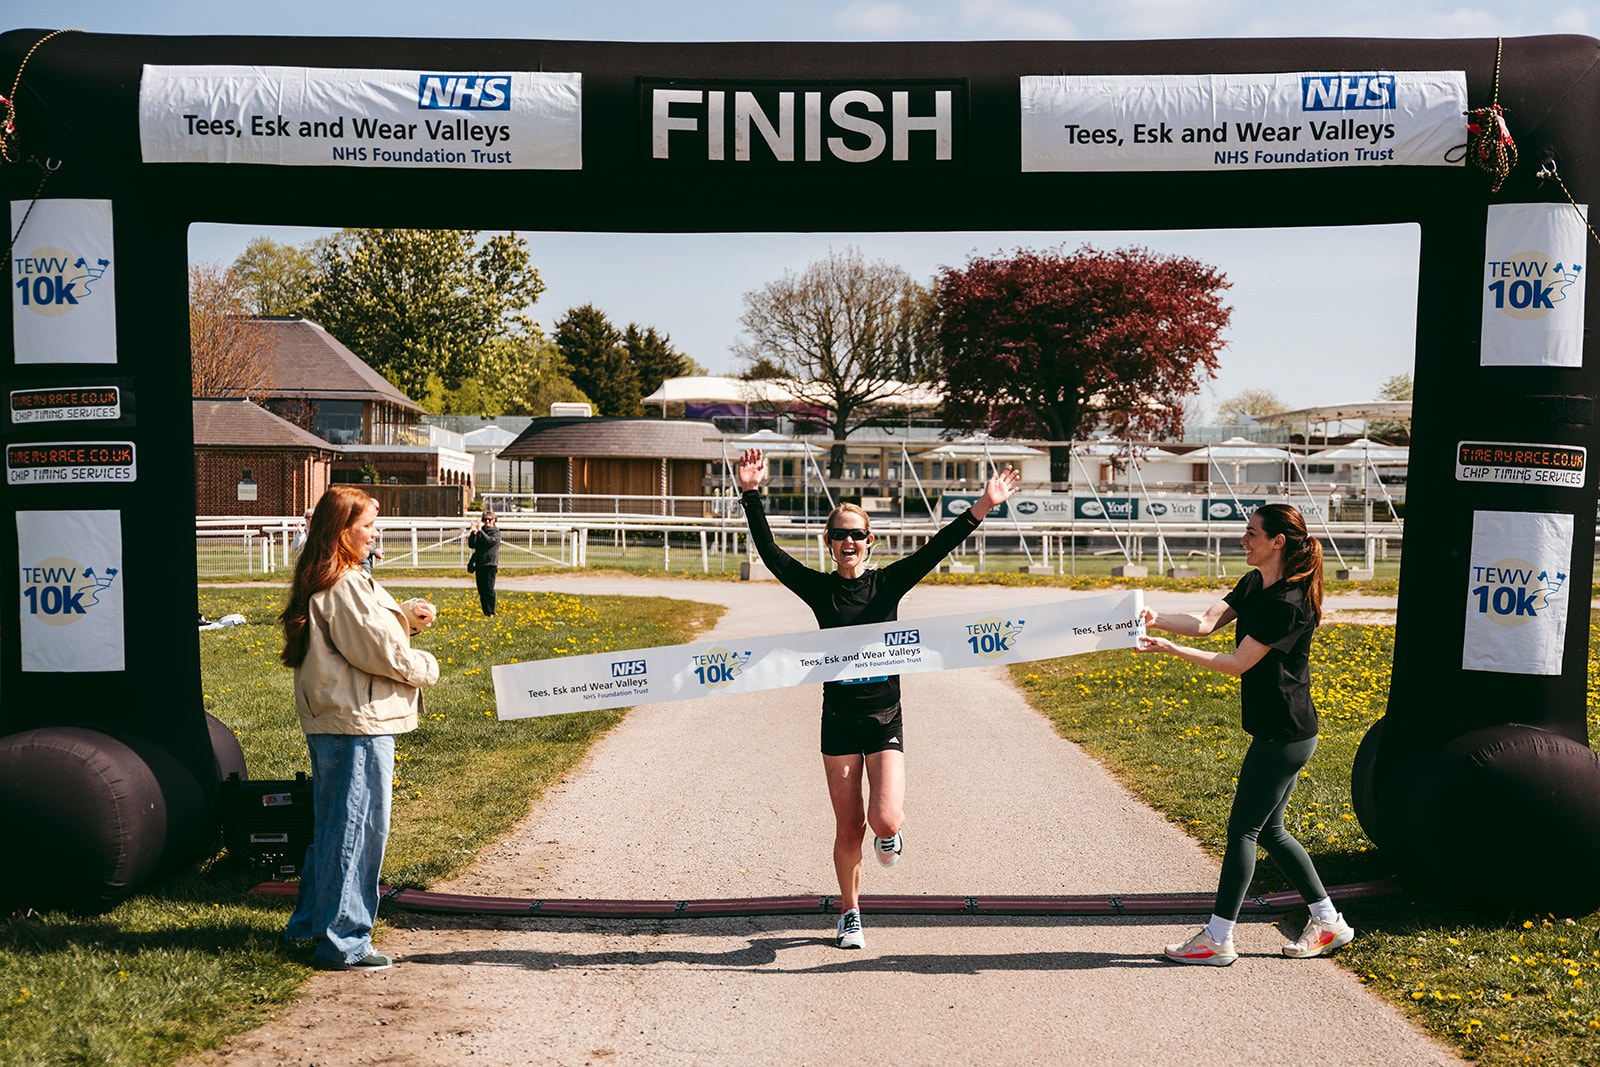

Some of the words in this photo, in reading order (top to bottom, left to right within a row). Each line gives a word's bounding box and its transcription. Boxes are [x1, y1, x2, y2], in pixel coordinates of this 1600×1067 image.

[419, 77, 509, 108] NHS
[1305, 77, 1391, 108] NHS
[183, 114, 242, 138] Tees,
[251, 115, 291, 137] Esk
[298, 116, 344, 138] and
[352, 118, 417, 140] Wear
[424, 119, 511, 147] Valleys
[652, 88, 952, 163] FINISH
[1064, 124, 1124, 146] Tees,
[1133, 122, 1174, 144] Esk
[1181, 122, 1227, 143] and
[1236, 122, 1302, 142] Wear
[1309, 119, 1395, 145] Valleys
[333, 147, 367, 161] NHS
[373, 147, 466, 163] Foundation
[471, 149, 512, 164] Trust
[1214, 150, 1249, 164] NHS
[1254, 149, 1349, 164] Foundation
[1354, 147, 1394, 161] Trust
[14, 257, 68, 274] TEWV
[1488, 261, 1548, 277] TEWV
[16, 275, 79, 305] 10k
[1488, 279, 1554, 309] 10k
[15, 411, 32, 421] CHIP
[35, 409, 64, 420] TIMING
[67, 407, 116, 418] SERVICES
[10, 470, 30, 481] CHIP
[33, 468, 67, 480] TIMING
[71, 467, 130, 479] SERVICES
[1462, 467, 1489, 479] CHIP
[1494, 468, 1531, 480] TIMING
[1535, 470, 1581, 485] SERVICES
[1042, 501, 1068, 512] York
[1106, 501, 1133, 513] York
[1171, 503, 1196, 513] York
[22, 567, 76, 583] TEWV
[1473, 566, 1533, 585] TEWV
[23, 585, 87, 615] 10k
[1472, 585, 1538, 617] 10k
[965, 621, 1002, 635] TEWV
[1072, 627, 1095, 635] Tees,
[1097, 622, 1113, 632] Esk
[1115, 619, 1133, 630] and
[886, 630, 918, 646] NHS
[967, 632, 1010, 654] 10k
[692, 652, 728, 666] TEWV
[800, 658, 823, 667] Tees,
[824, 654, 840, 664] Esk
[842, 651, 859, 662] and
[861, 650, 886, 660] Wear
[888, 646, 921, 658] Valleys
[869, 659, 905, 668] Foundation
[613, 660, 645, 676] NHS
[694, 663, 735, 684] 10k
[528, 690, 550, 698] Tees,
[553, 686, 568, 695] Esk
[570, 683, 587, 694] and
[589, 681, 613, 691] Wear
[615, 678, 648, 688] Valleys
[597, 690, 632, 699] Foundation
